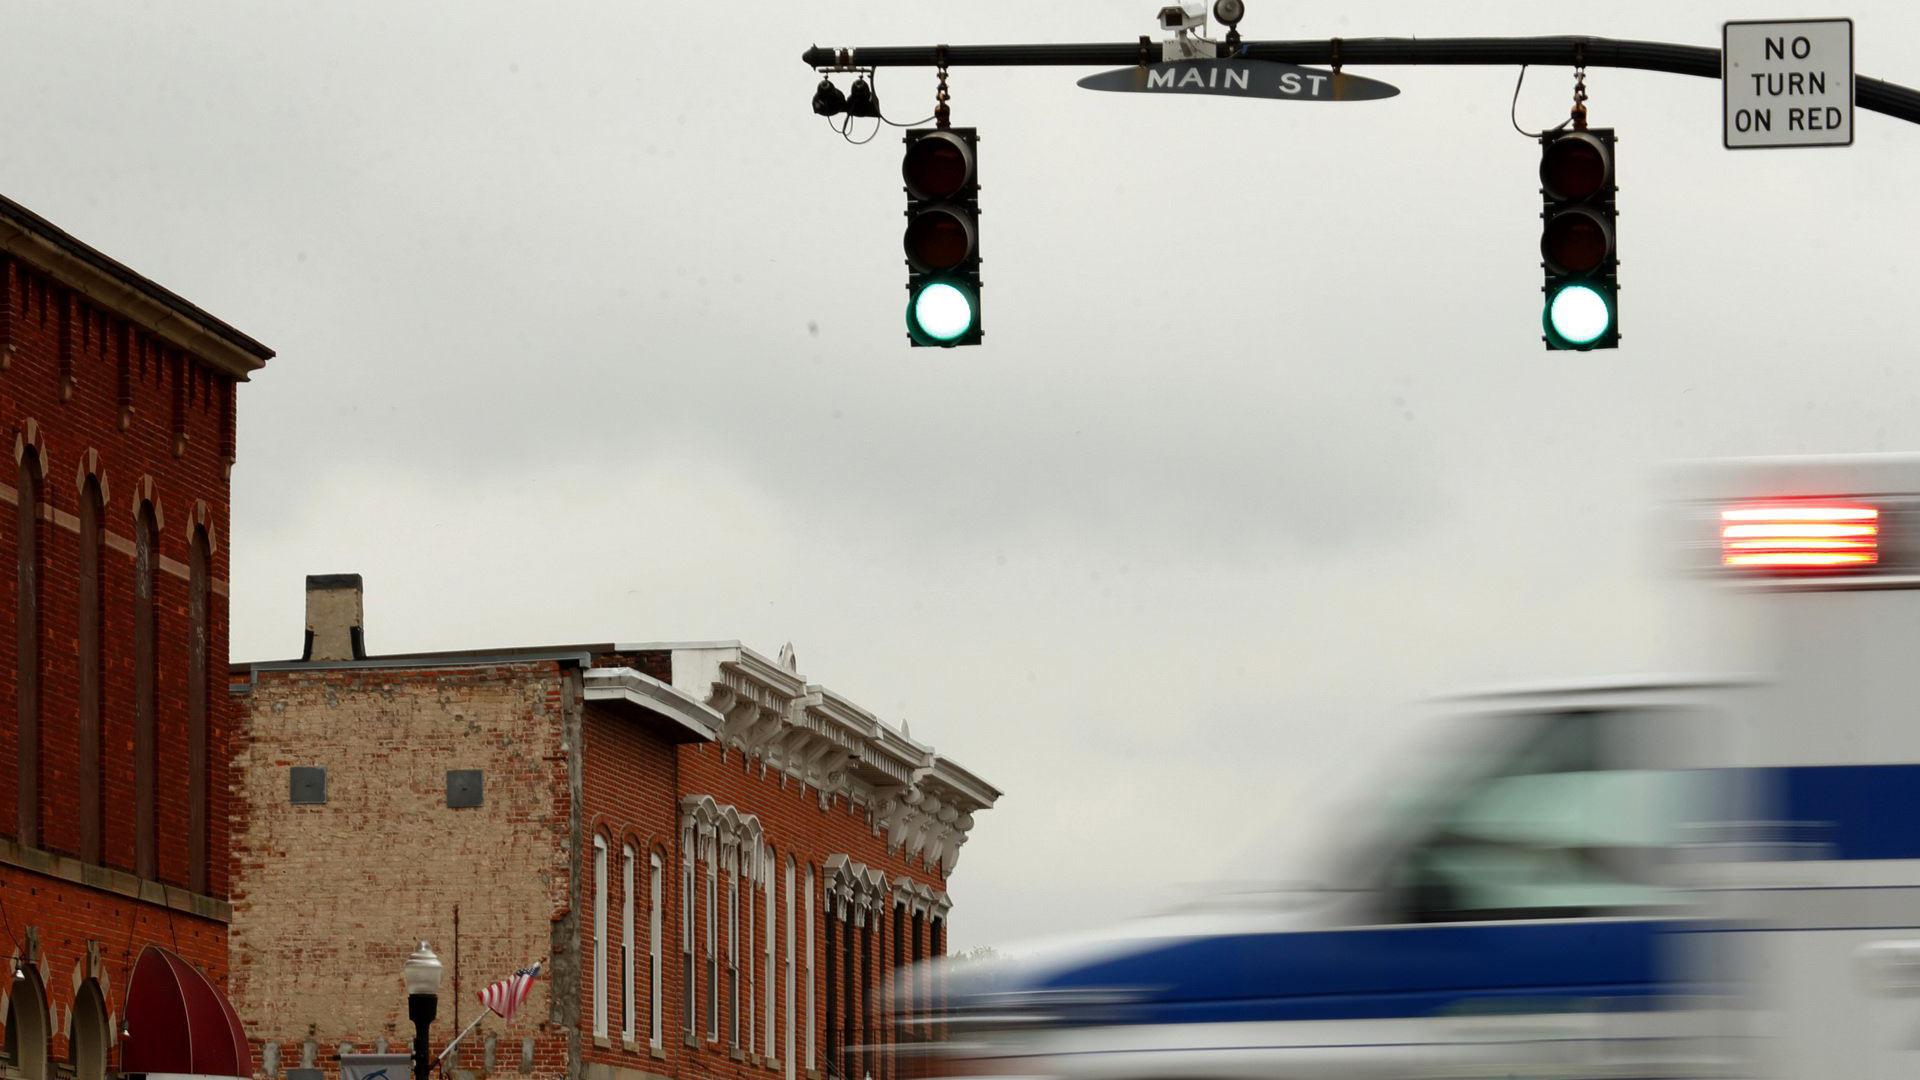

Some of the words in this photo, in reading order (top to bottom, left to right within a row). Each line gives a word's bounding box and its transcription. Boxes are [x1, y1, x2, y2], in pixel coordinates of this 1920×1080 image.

[1765, 36, 1811, 60] NO
[1147, 68, 1249, 90] MAIN
[1278, 72, 1327, 96] ST
[1751, 71, 1825, 96] TURN
[1735, 108, 1771, 132] ON
[1788, 106, 1842, 131] RED
